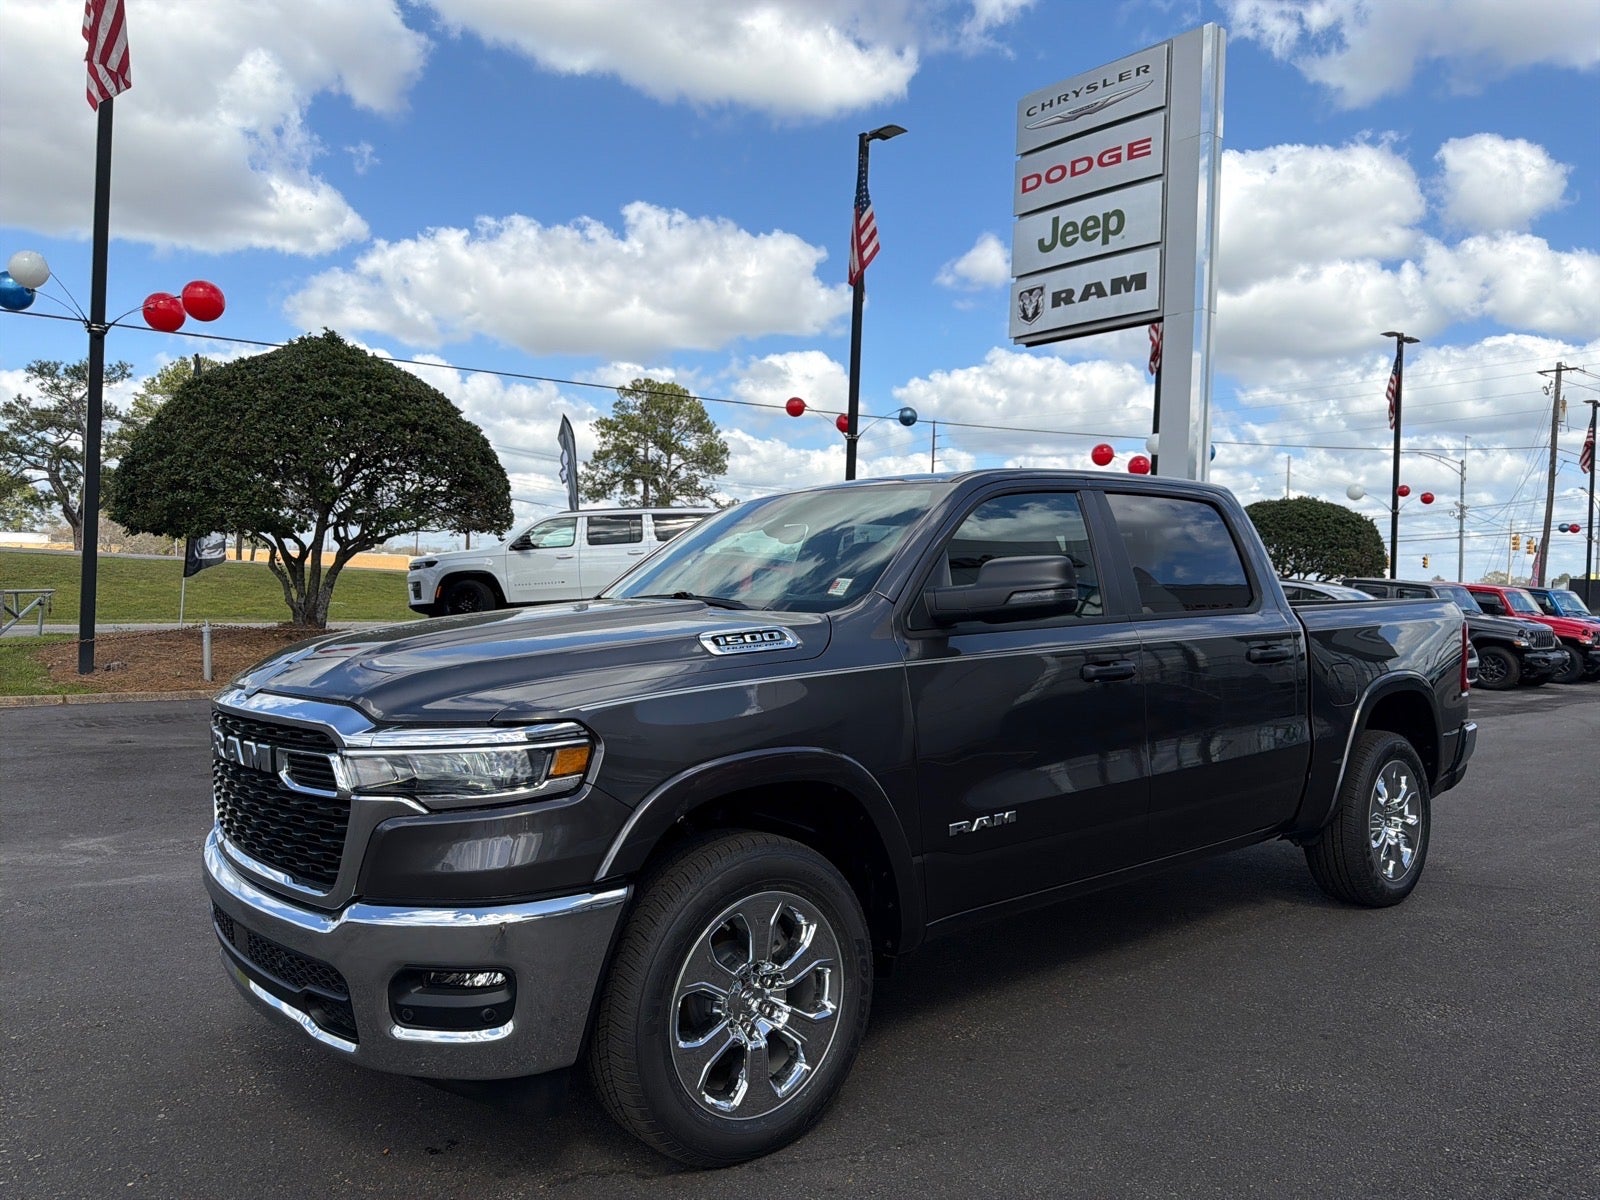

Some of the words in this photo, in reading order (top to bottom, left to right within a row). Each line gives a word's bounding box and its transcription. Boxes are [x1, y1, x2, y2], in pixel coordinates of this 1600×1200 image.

[1026, 64, 1151, 117] CHRYSLER
[1021, 137, 1152, 194] DODGE
[1038, 208, 1125, 253] Jeep
[1051, 271, 1147, 309] RAM
[714, 630, 781, 646] 1500
[212, 726, 272, 773] RAM
[949, 810, 1017, 836] RAM
